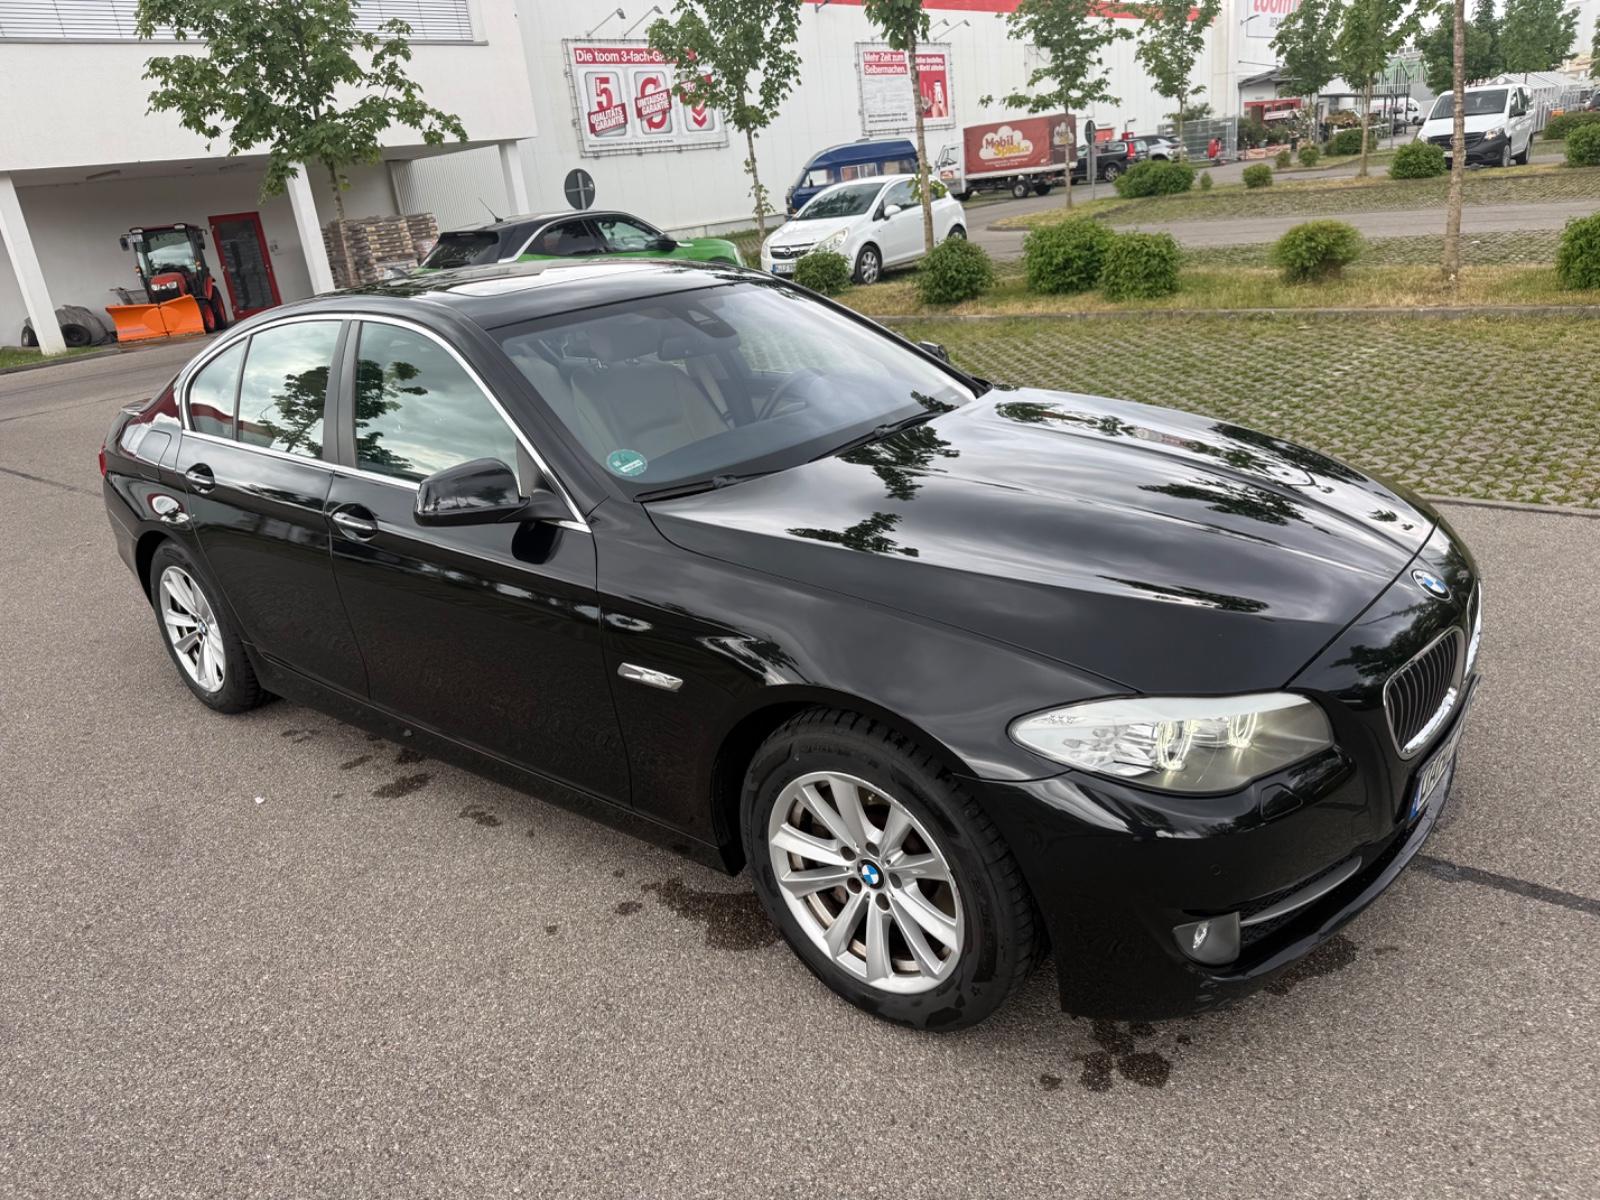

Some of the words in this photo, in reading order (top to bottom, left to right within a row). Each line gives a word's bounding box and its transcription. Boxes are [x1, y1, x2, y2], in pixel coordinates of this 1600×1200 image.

[575, 50, 593, 62] Die
[594, 49, 620, 62] toom
[621, 50, 666, 62] 3-fach-G
[985, 134, 1014, 149] Mobil
